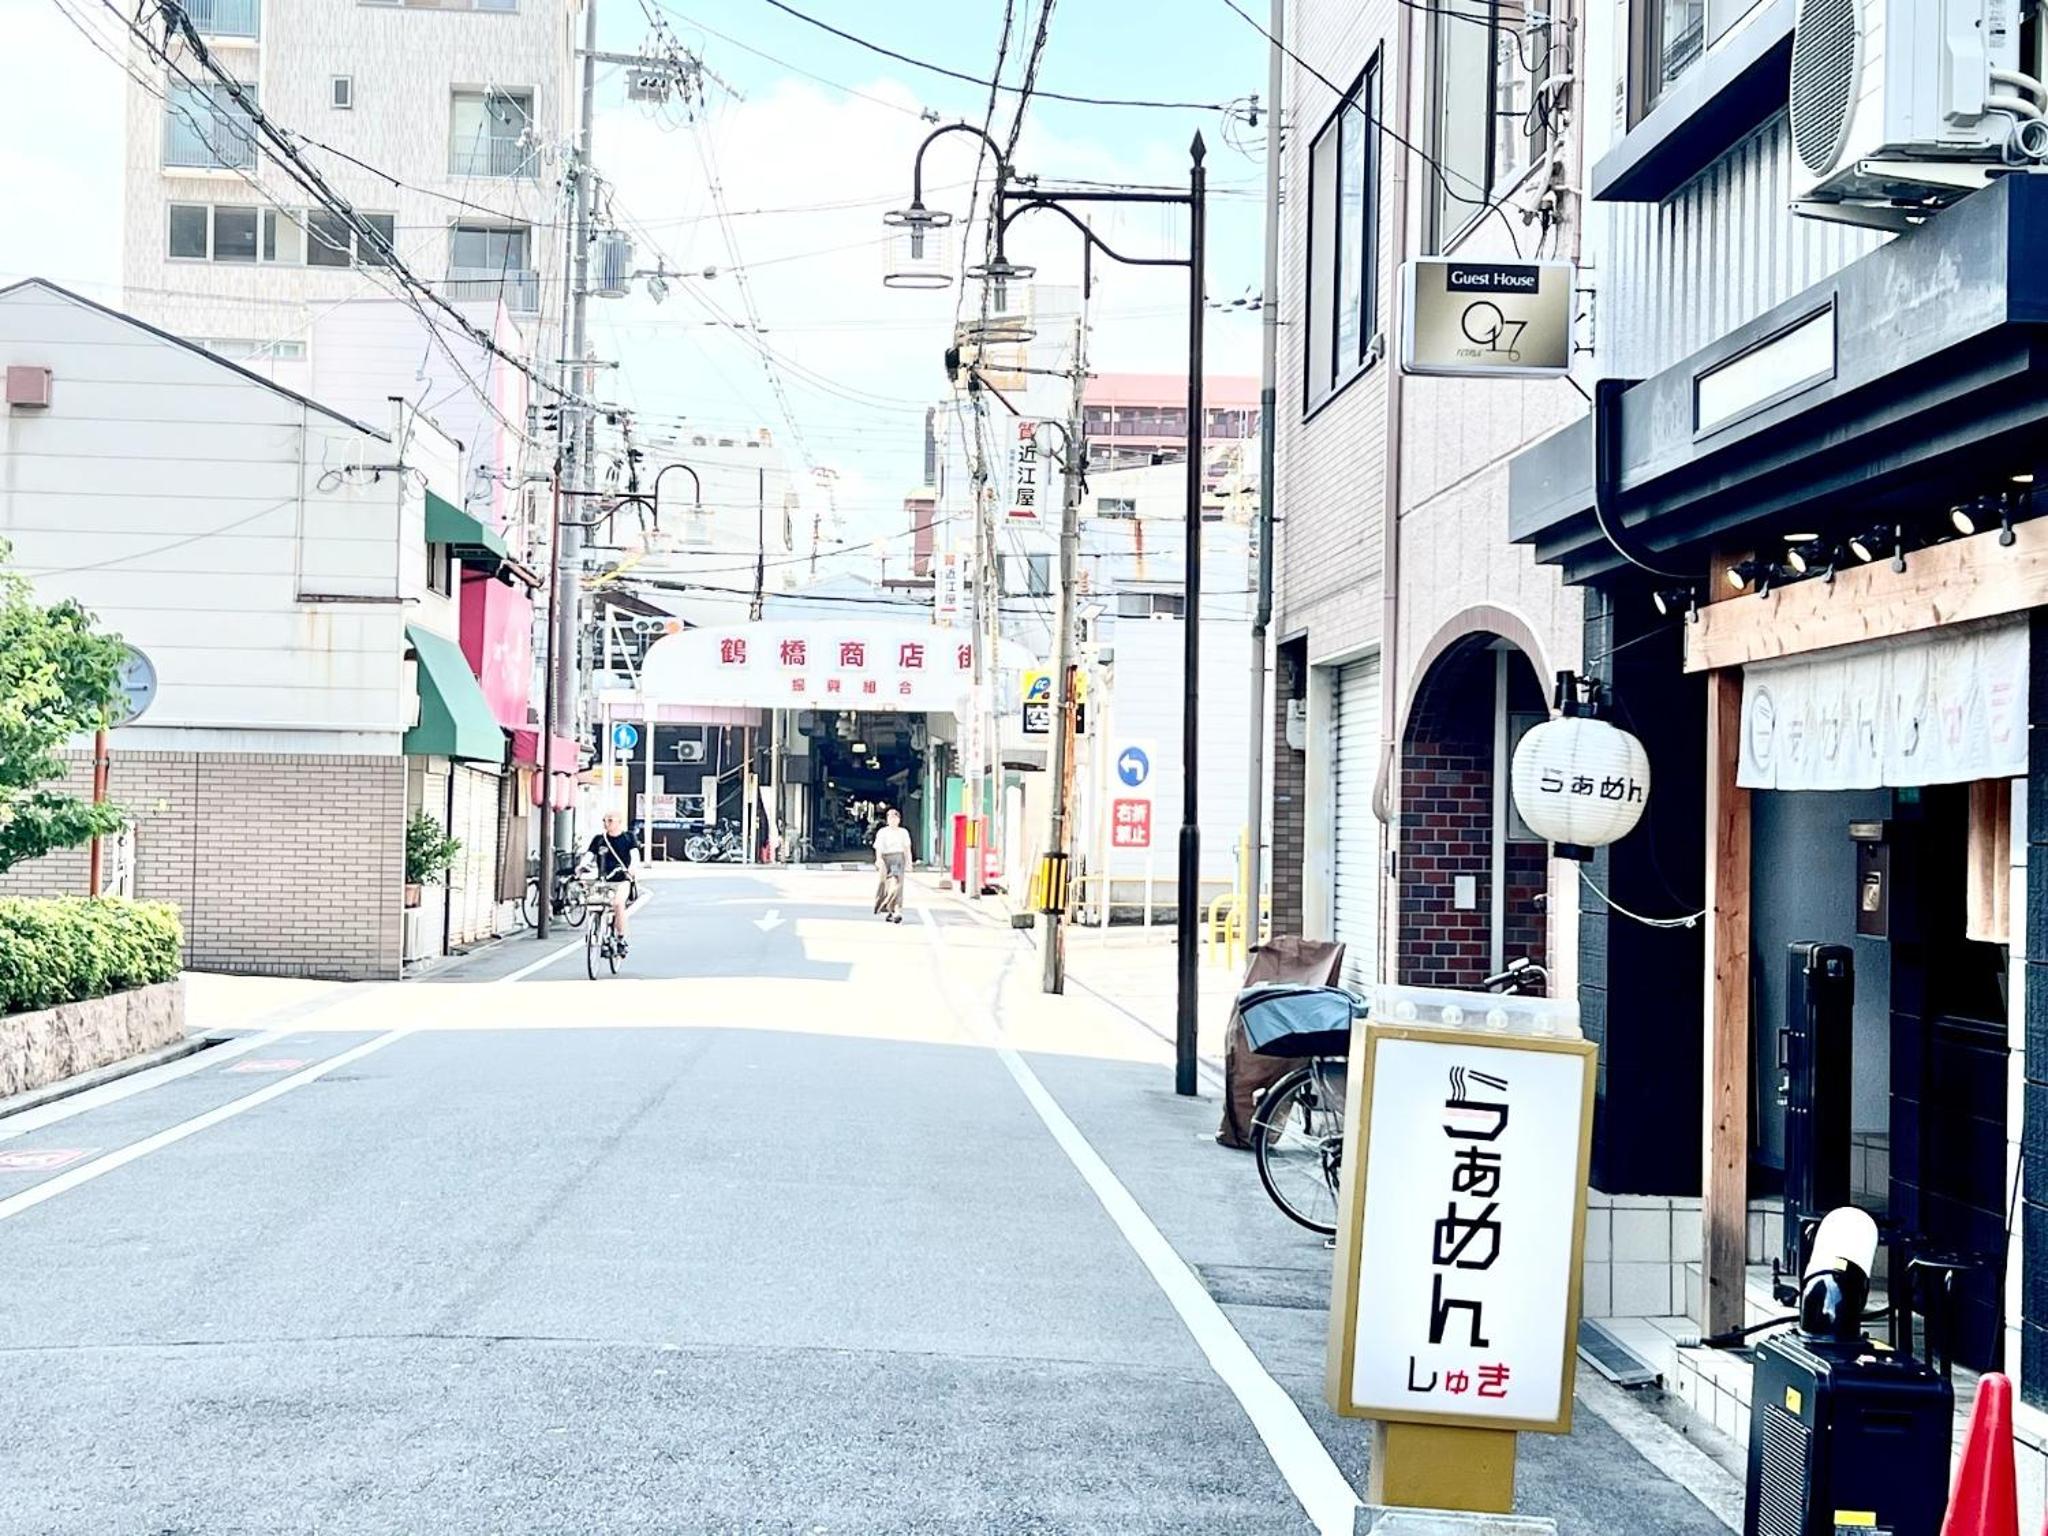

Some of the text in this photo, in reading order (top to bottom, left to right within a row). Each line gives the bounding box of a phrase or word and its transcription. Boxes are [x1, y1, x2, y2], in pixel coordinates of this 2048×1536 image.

[1450, 271, 1536, 288] Guest House
[1407, 1355, 1511, 1398] しゅき
